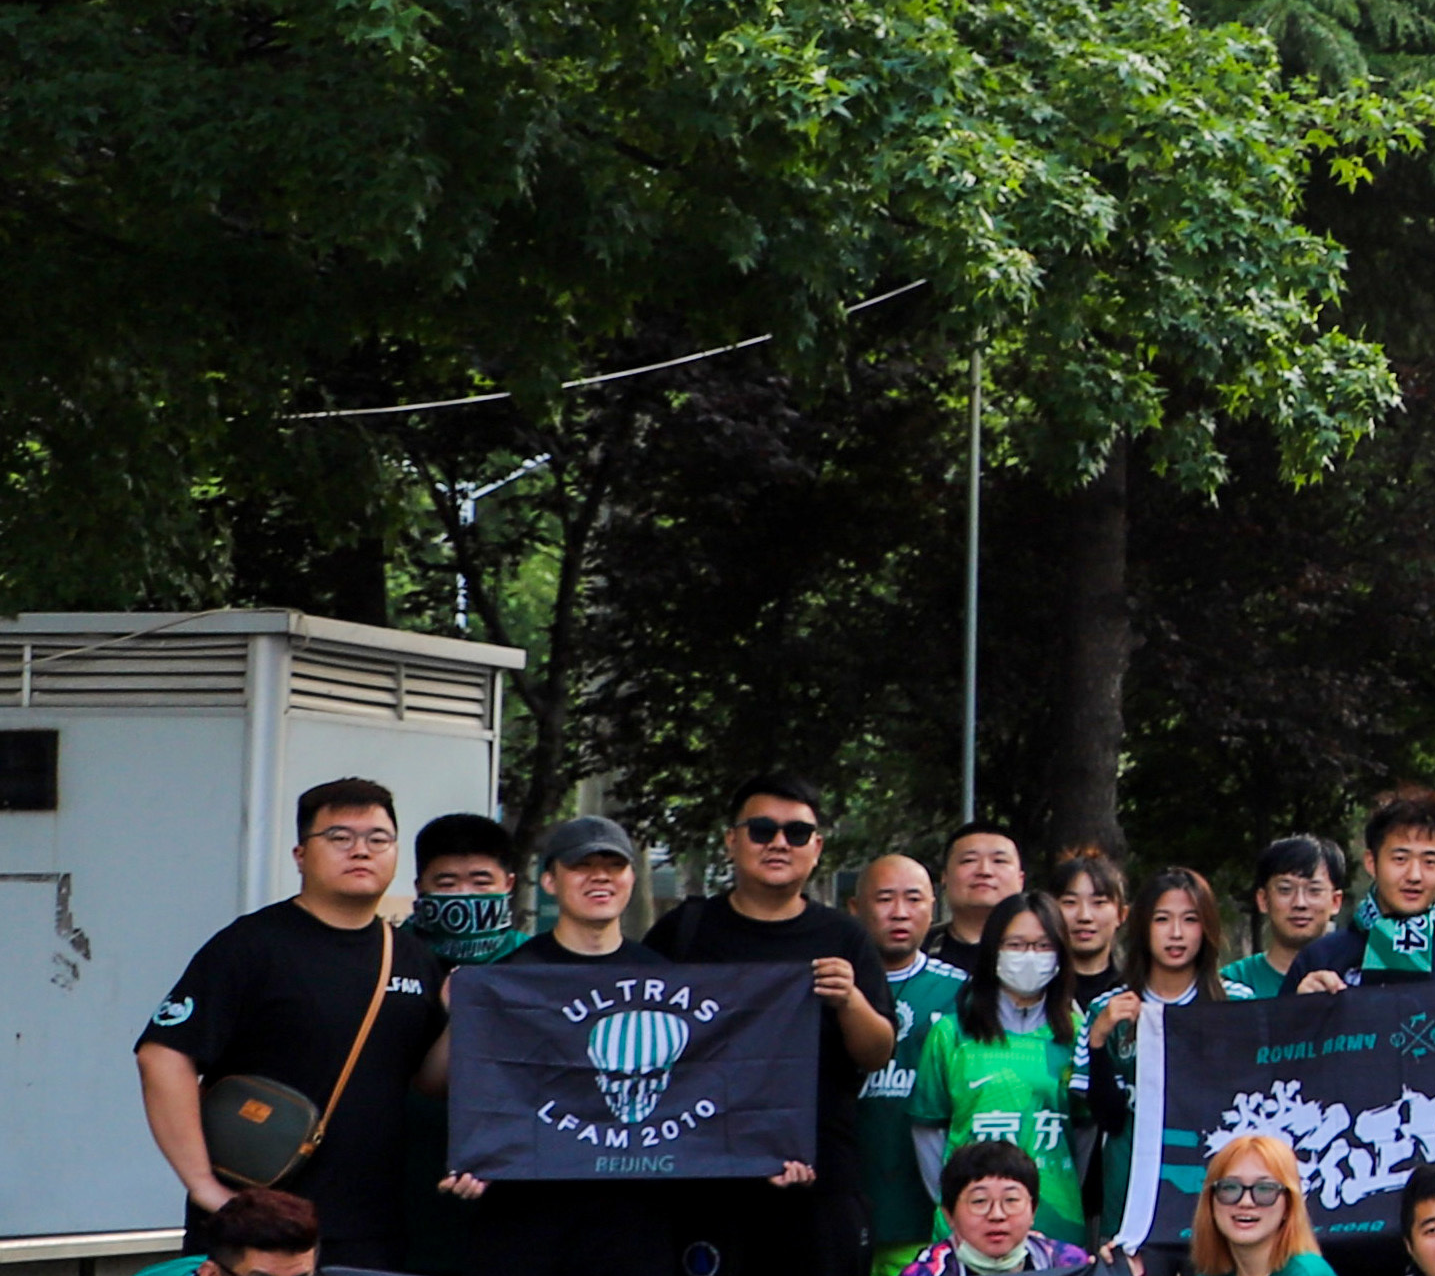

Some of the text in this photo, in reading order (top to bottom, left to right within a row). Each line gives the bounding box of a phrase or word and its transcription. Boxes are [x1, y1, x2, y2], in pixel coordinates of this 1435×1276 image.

[562, 979, 720, 1023] ULTRAS
[1256, 1040, 1315, 1065] ROYAL
[1321, 1032, 1376, 1056] ARMY
[537, 1099, 717, 1148] LFAM 2010
[972, 1110, 1068, 1150] 京东
[595, 1155, 675, 1173] BEIJING
